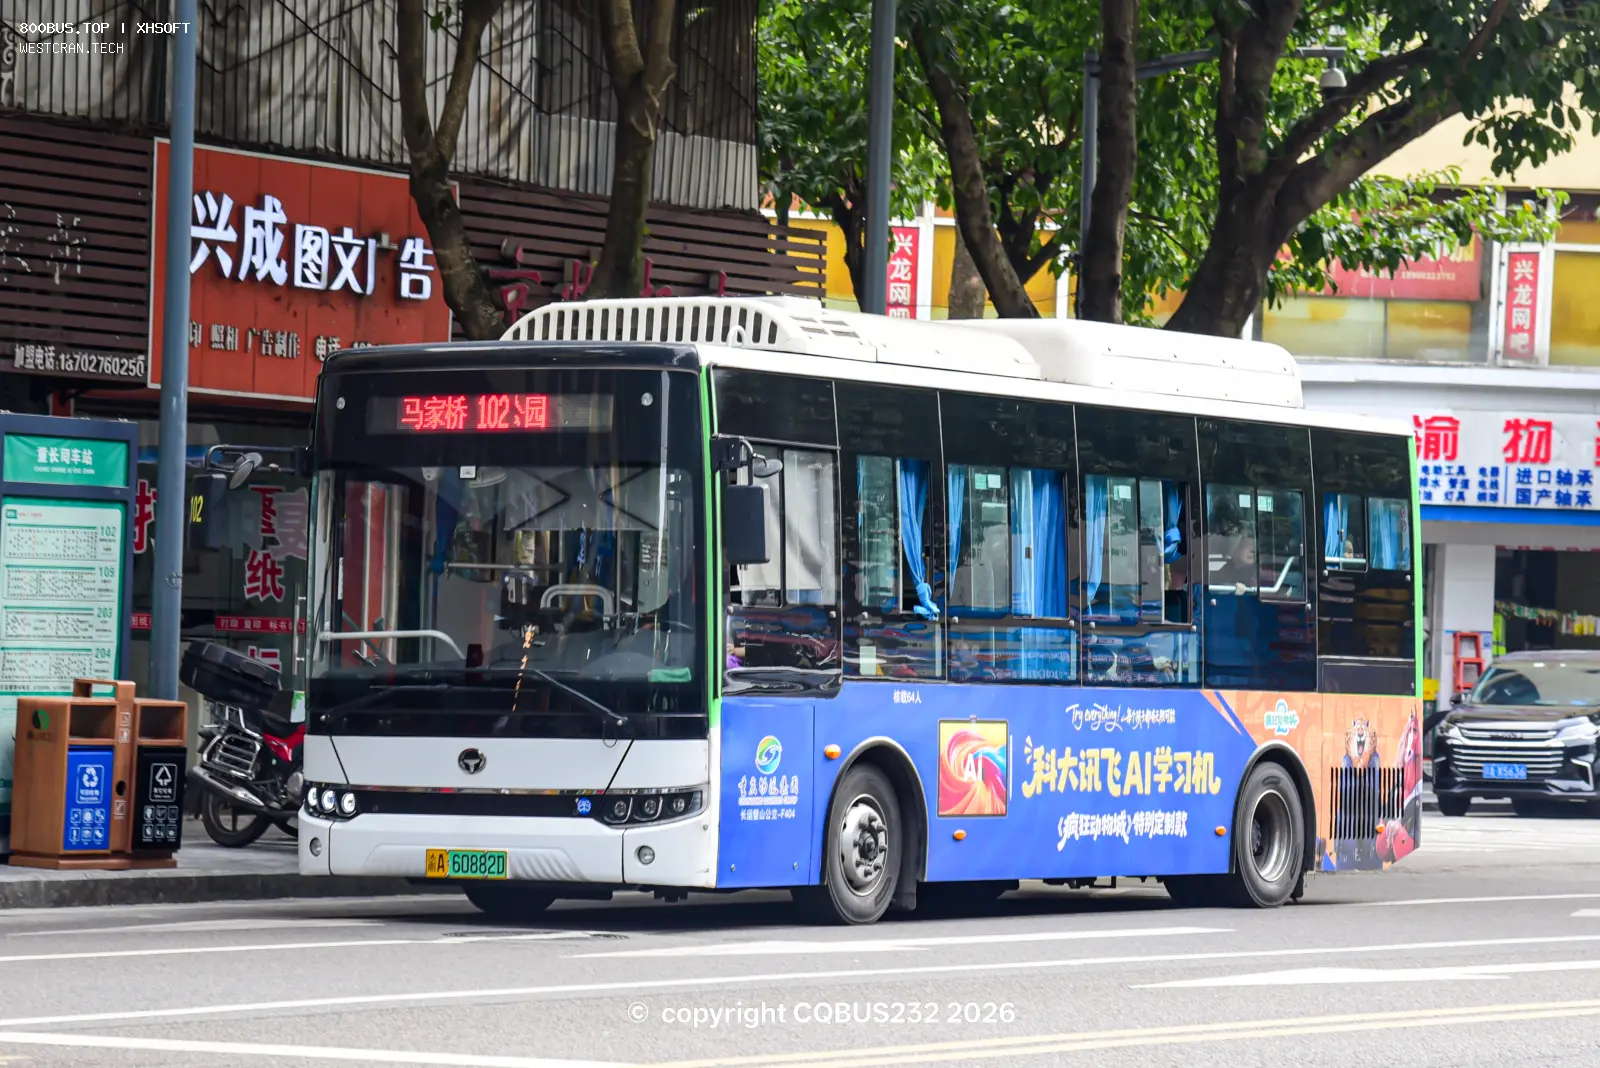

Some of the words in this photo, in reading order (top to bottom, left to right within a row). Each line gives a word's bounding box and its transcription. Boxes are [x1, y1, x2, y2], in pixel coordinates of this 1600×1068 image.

[189, 190, 434, 301] 兴成图文广告
[1510, 259, 1535, 354] 兴龙网吧
[401, 395, 468, 430] 马家桥
[476, 394, 510, 430] 102
[1516, 467, 1593, 486] 进口轴承
[1515, 487, 1593, 507] 国产轴承
[100, 525, 117, 537] 102
[94, 647, 111, 659] 204
[1065, 703, 1083, 731] Try
[963, 752, 983, 782] AI
[1022, 745, 1222, 798] 科大讯飞AI学习机
